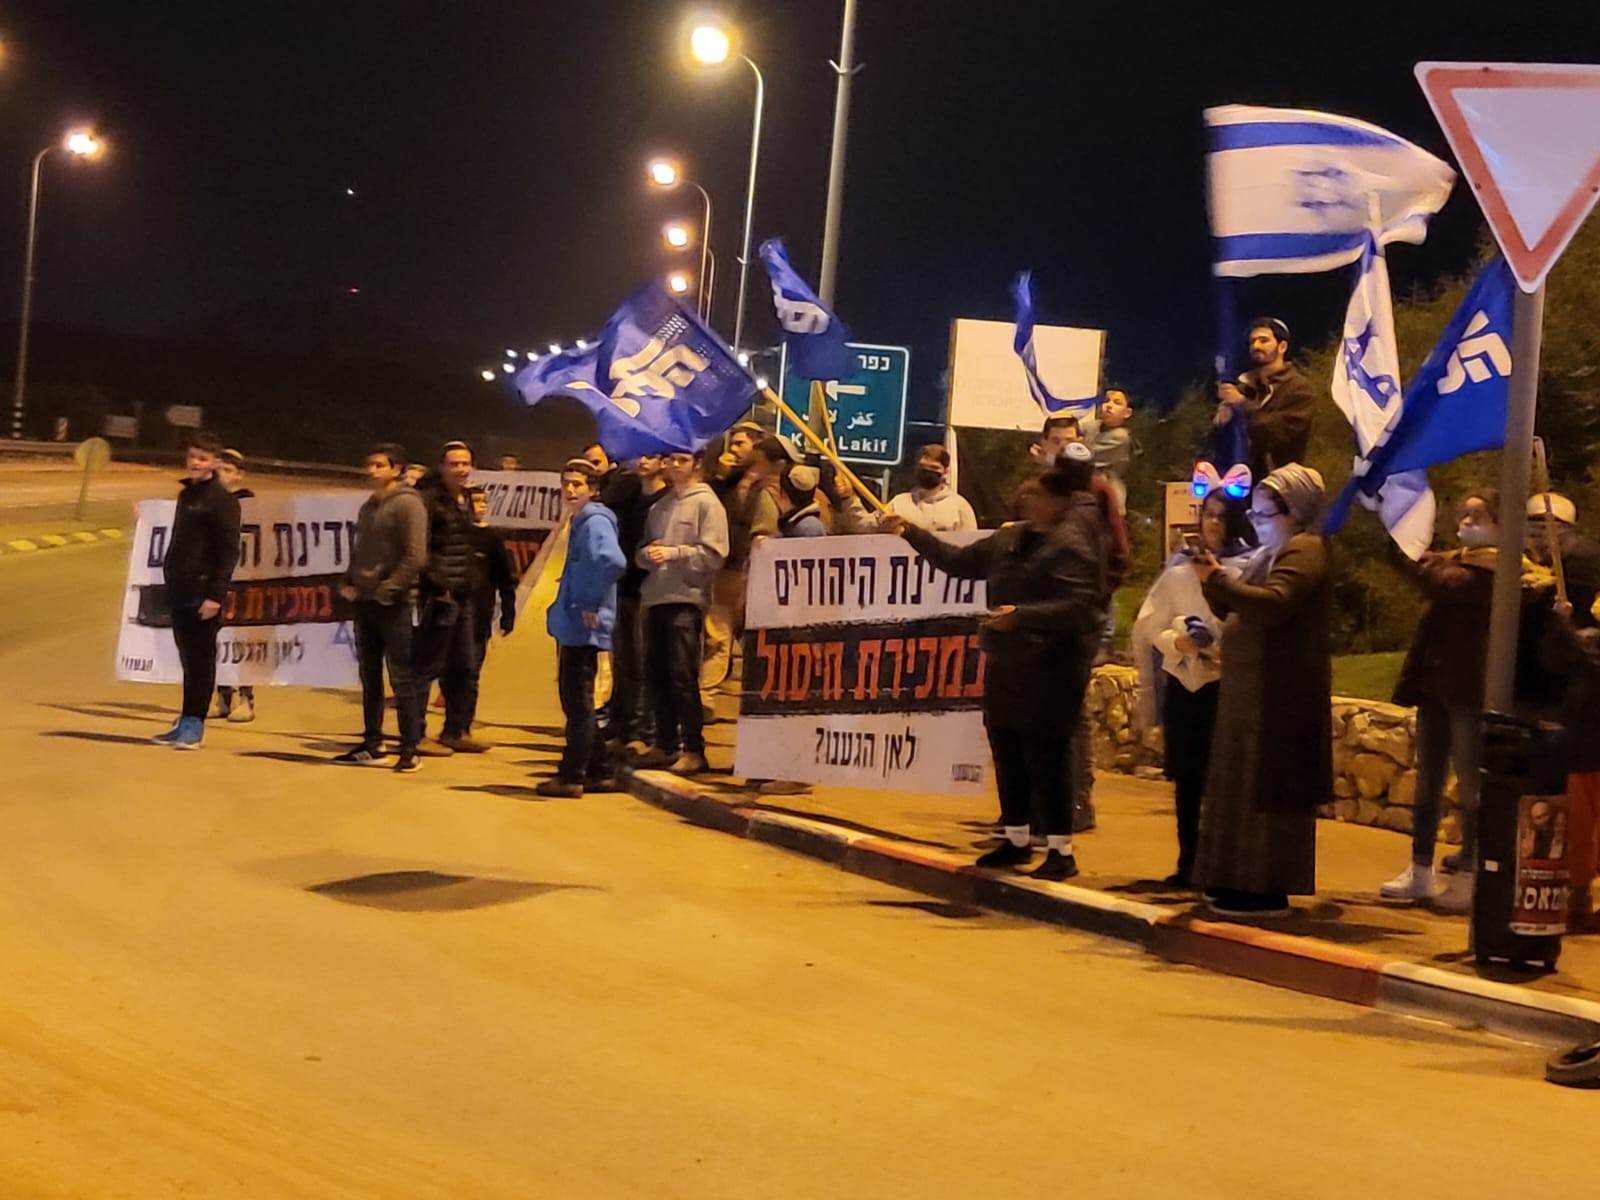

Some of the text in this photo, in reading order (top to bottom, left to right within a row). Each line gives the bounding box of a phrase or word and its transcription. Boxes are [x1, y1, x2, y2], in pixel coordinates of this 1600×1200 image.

[857, 354, 891, 371] כפר
[791, 432, 888, 453] Kr Lakif
[774, 557, 876, 607] היהודים
[756, 629, 845, 701] חיסול
[815, 727, 875, 768] הגענו?
[882, 726, 916, 778] לאן
